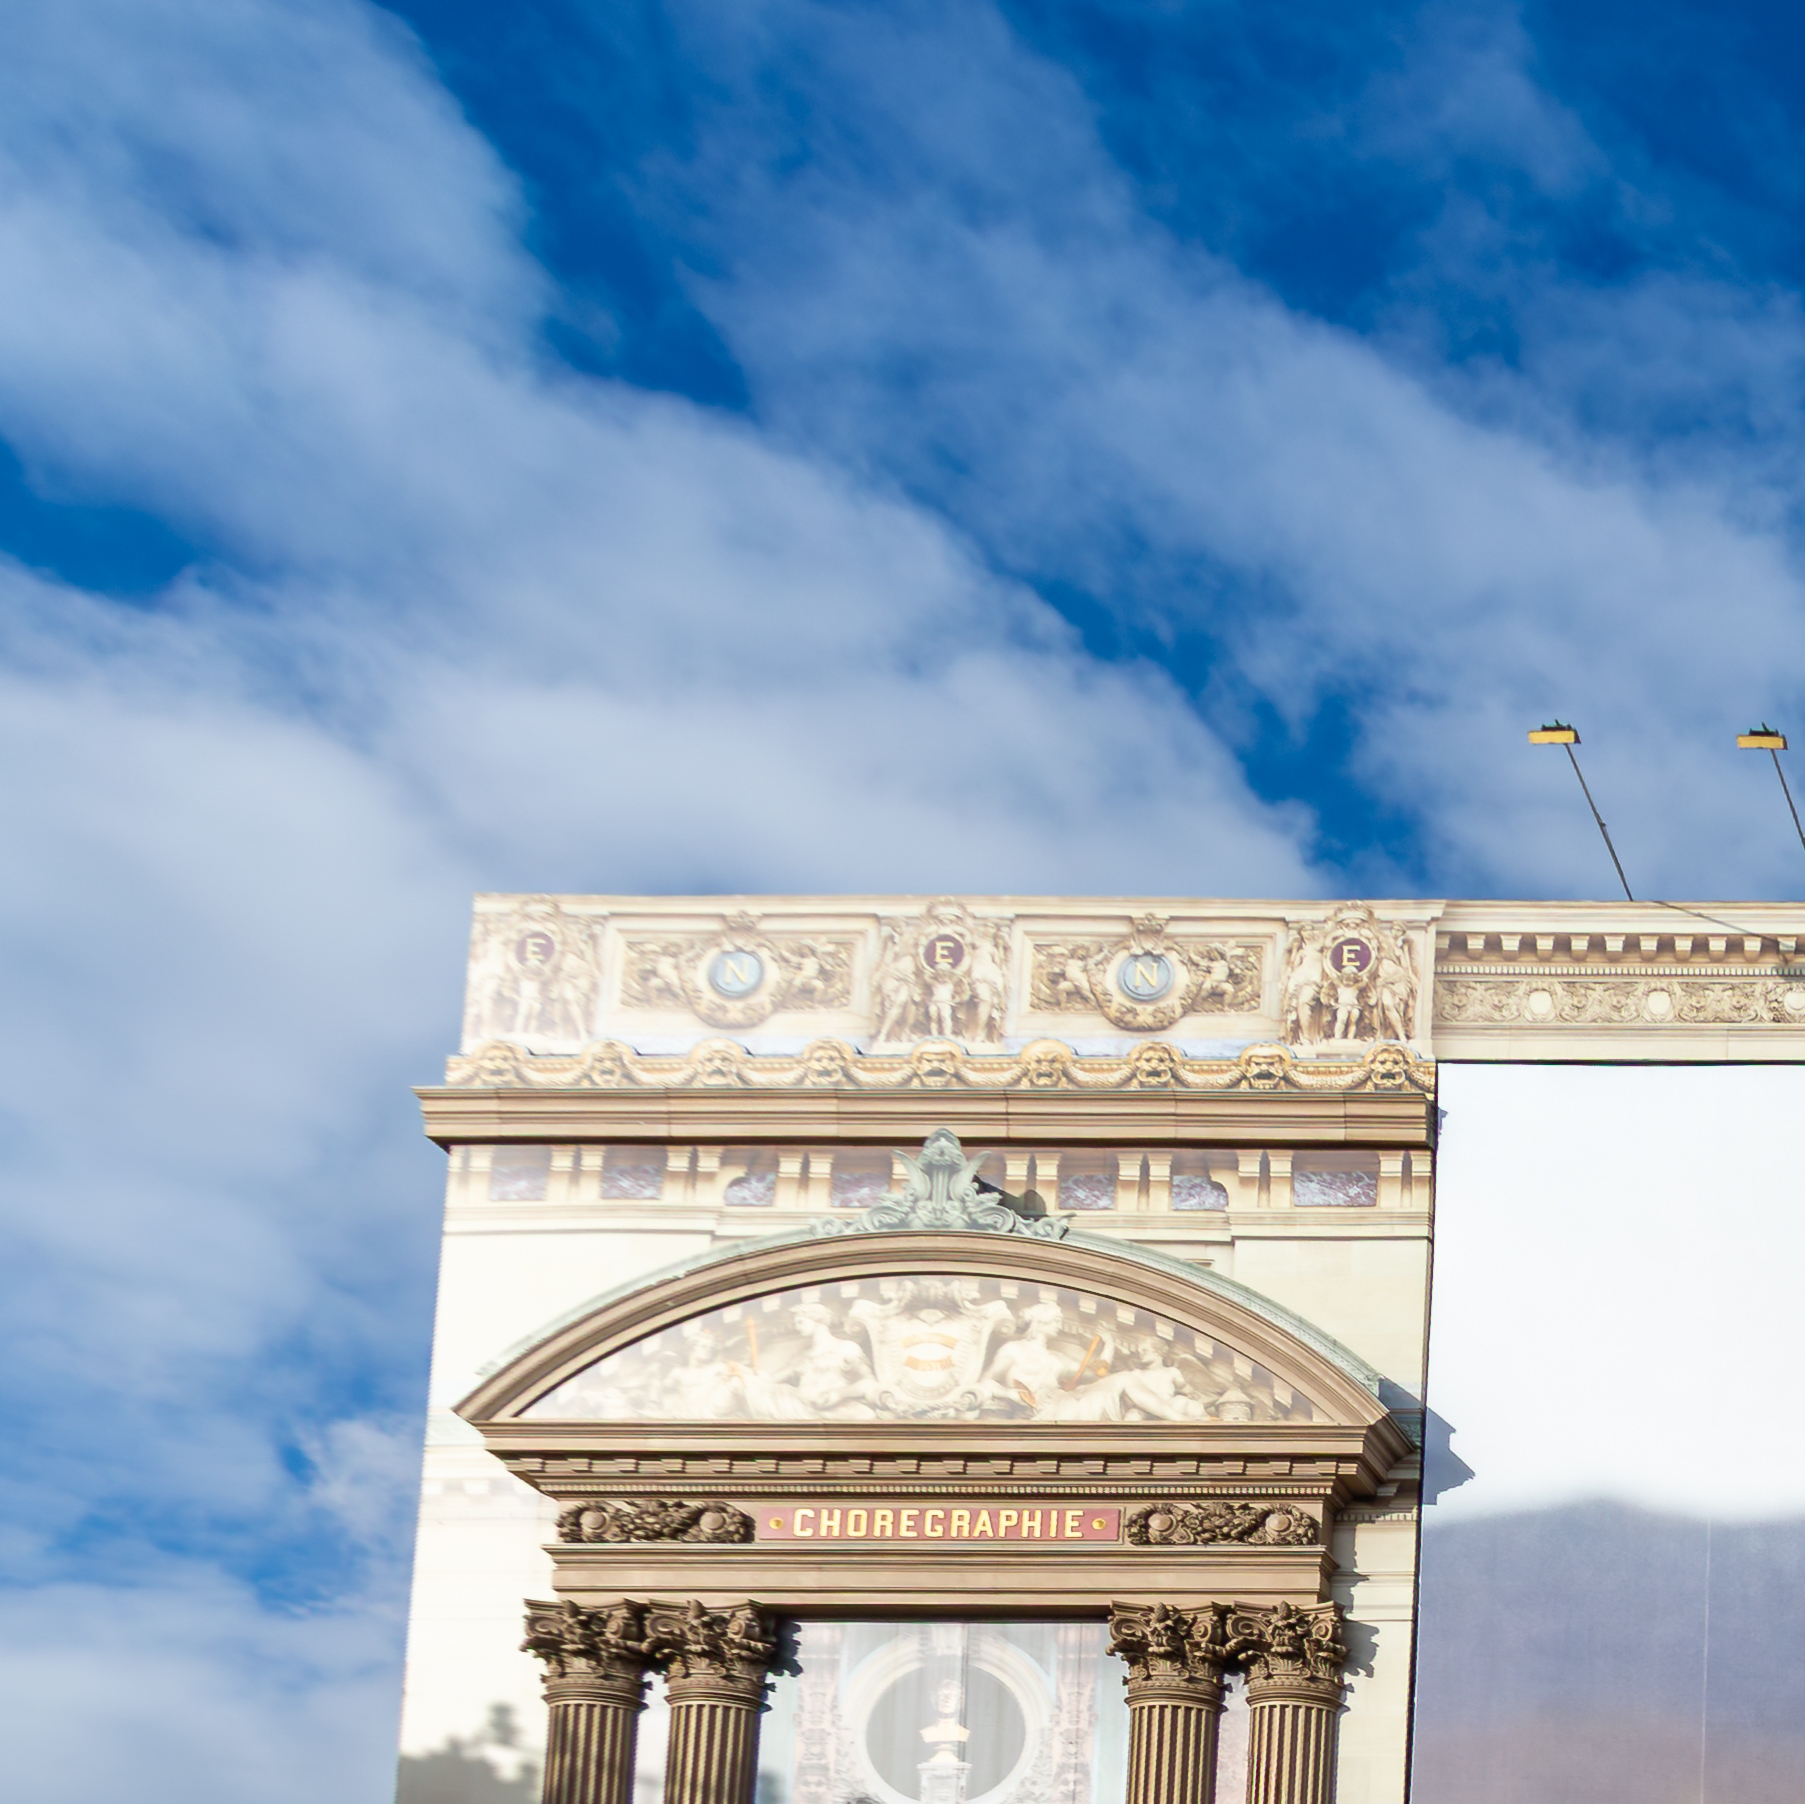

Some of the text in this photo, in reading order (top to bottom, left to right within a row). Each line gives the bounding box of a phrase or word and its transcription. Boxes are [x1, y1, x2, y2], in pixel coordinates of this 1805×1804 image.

[526, 938, 545, 959] E
[935, 941, 954, 963] E
[1341, 945, 1360, 966] E
[724, 959, 747, 984] N
[1134, 962, 1158, 987] N
[792, 1508, 1084, 1538] CHOREGRAPHIE
